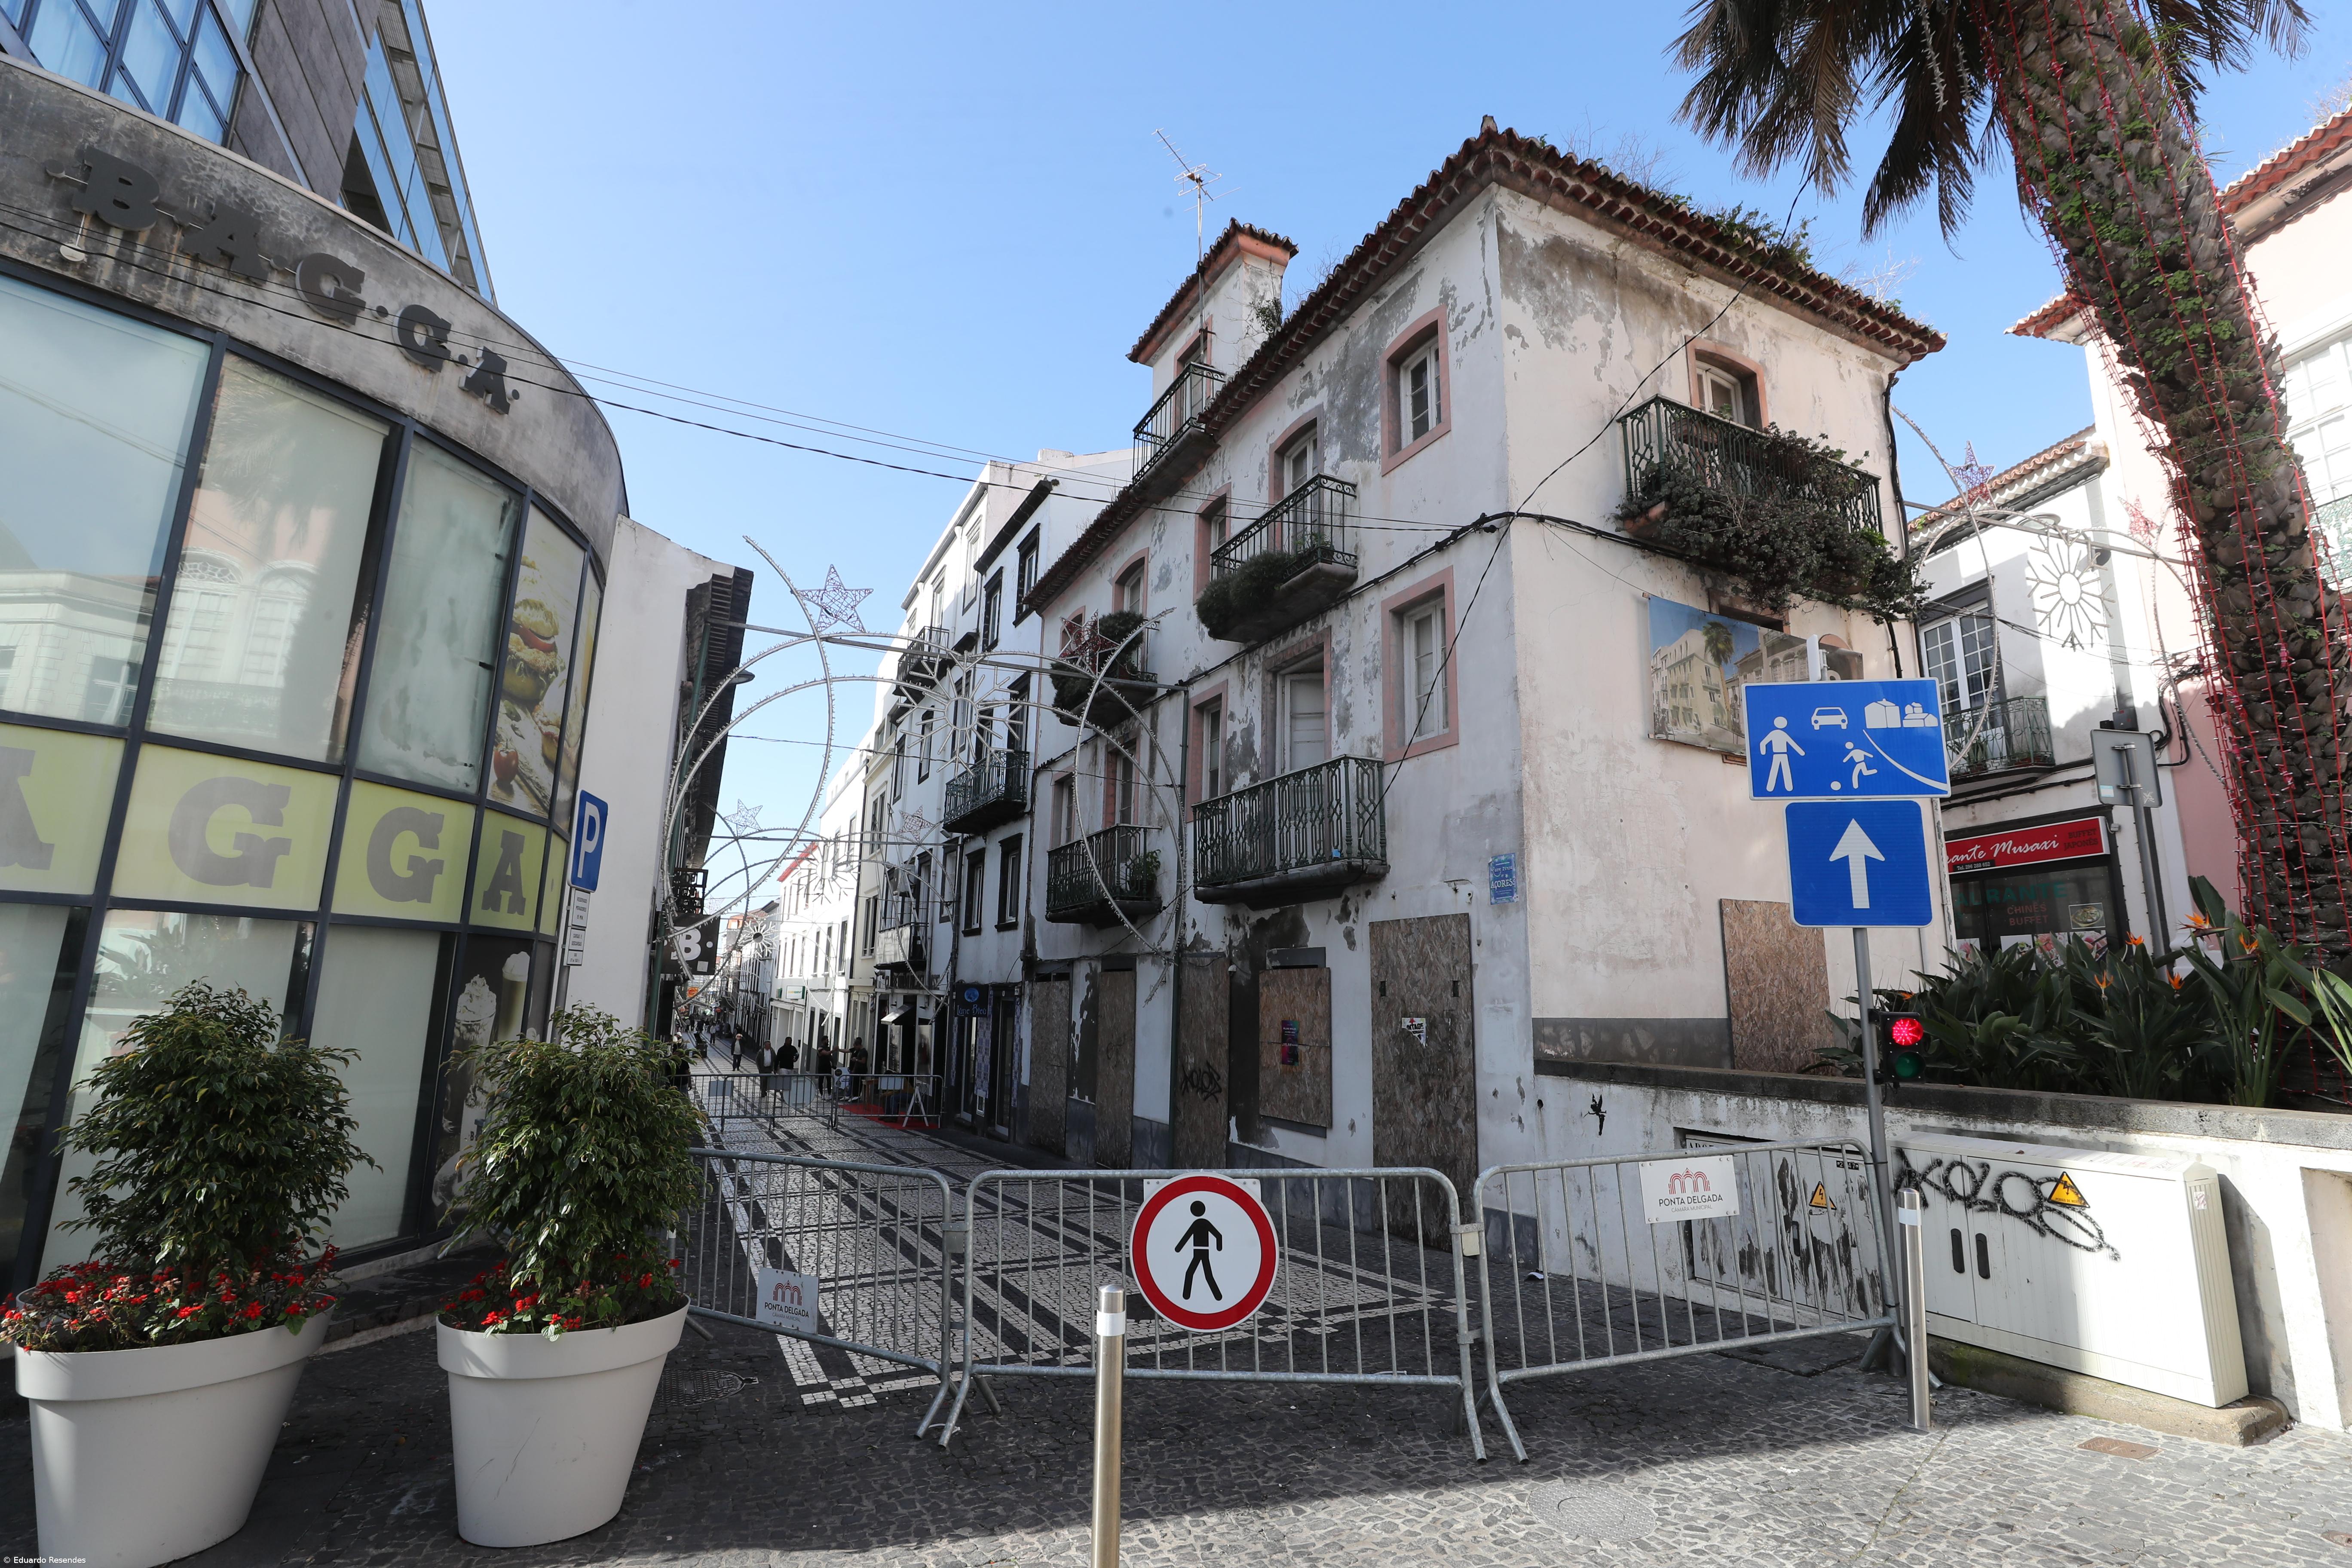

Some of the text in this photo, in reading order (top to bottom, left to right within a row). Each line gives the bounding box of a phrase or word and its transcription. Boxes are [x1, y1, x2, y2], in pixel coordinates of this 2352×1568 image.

[577, 800, 600, 879] P
[2068, 828, 2097, 839] BUFFET
[1990, 834, 2059, 858] Musaxi
[2009, 915, 2049, 926] BUFFET
[1659, 1194, 1723, 1207] PONTA DELGADA
[764, 1302, 809, 1318] PONTA DELGADA
